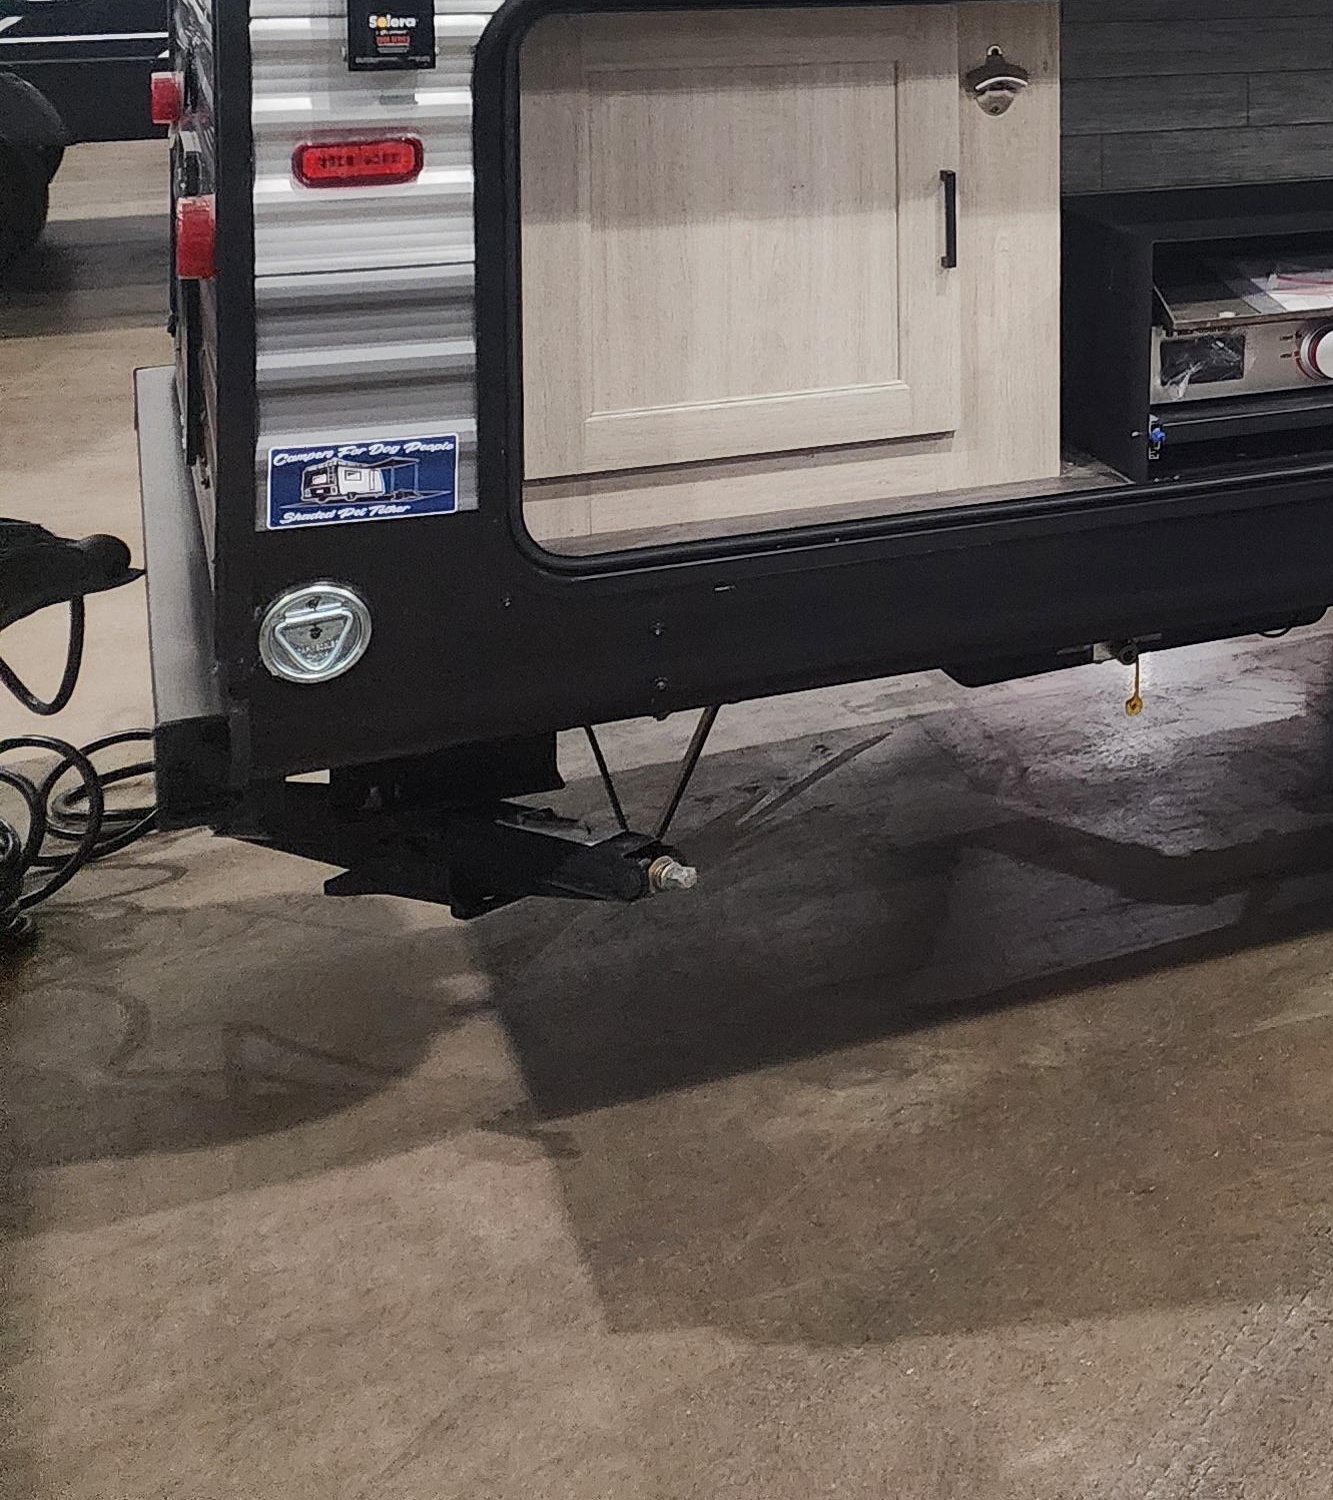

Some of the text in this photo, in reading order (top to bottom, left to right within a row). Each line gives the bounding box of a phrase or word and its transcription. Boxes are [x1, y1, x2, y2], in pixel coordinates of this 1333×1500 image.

[368, 13, 417, 29] Solera
[273, 441, 455, 467] Campers For Dog People
[279, 505, 411, 525] Shaded Pet Tether
